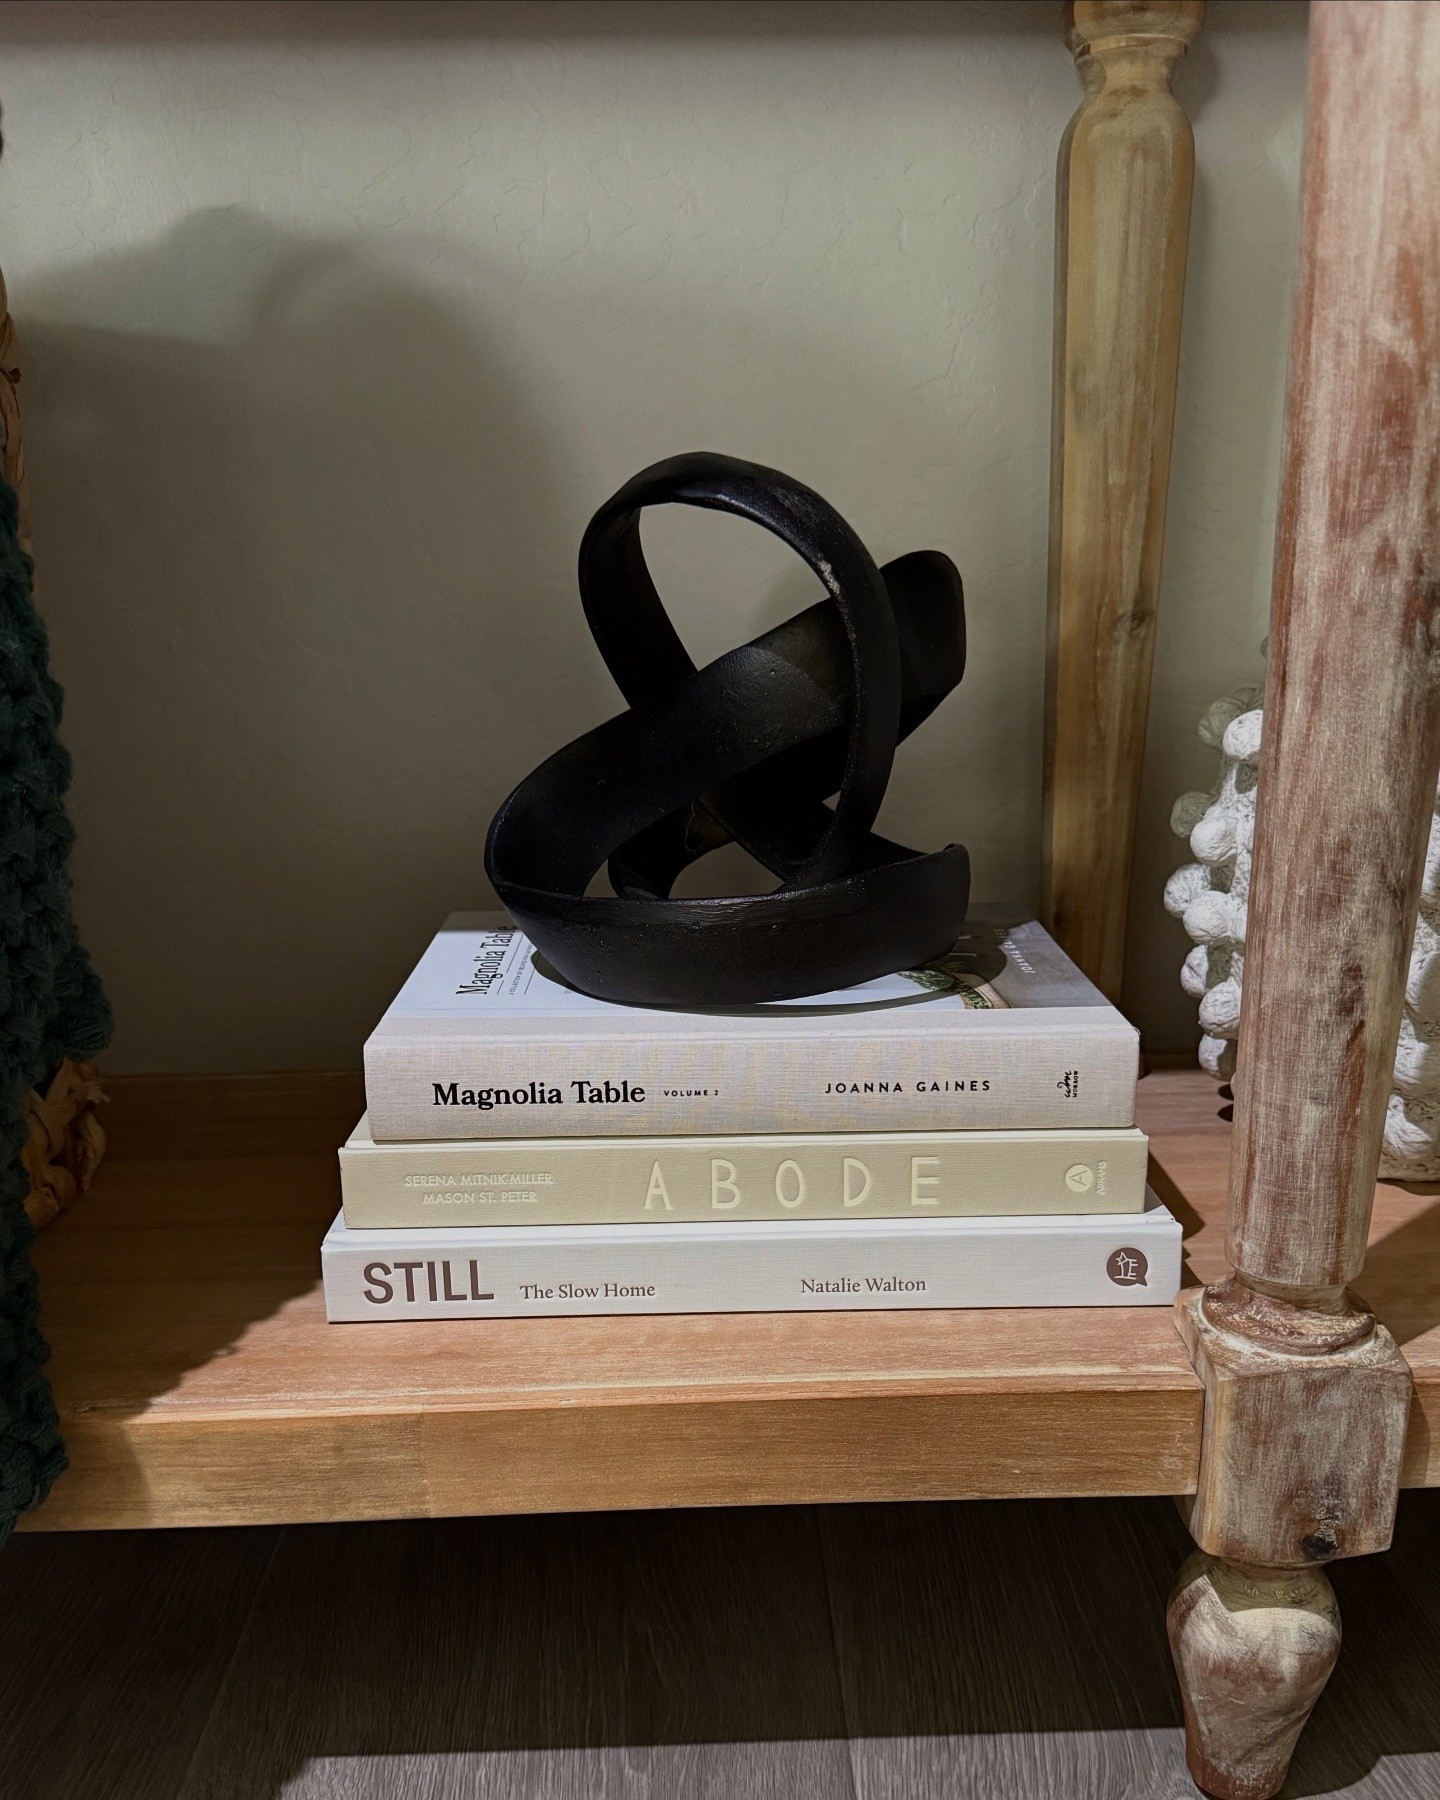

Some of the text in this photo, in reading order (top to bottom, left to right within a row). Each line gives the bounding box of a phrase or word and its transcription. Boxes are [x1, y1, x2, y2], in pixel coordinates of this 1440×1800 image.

[456, 926, 518, 995] Magnolia Table
[1009, 950, 1036, 974] JOANNA
[432, 1079, 720, 1110] Magnolia Table VOLUME 2
[825, 1080, 991, 1094] JOANNA GAINES
[404, 1172, 554, 1188] SERENA MITNIK-MILLER
[422, 1190, 537, 1205] MASON ST. PETER
[363, 1260, 656, 1304] STILL The Slow Home
[801, 1275, 927, 1294] Natalie Walton
